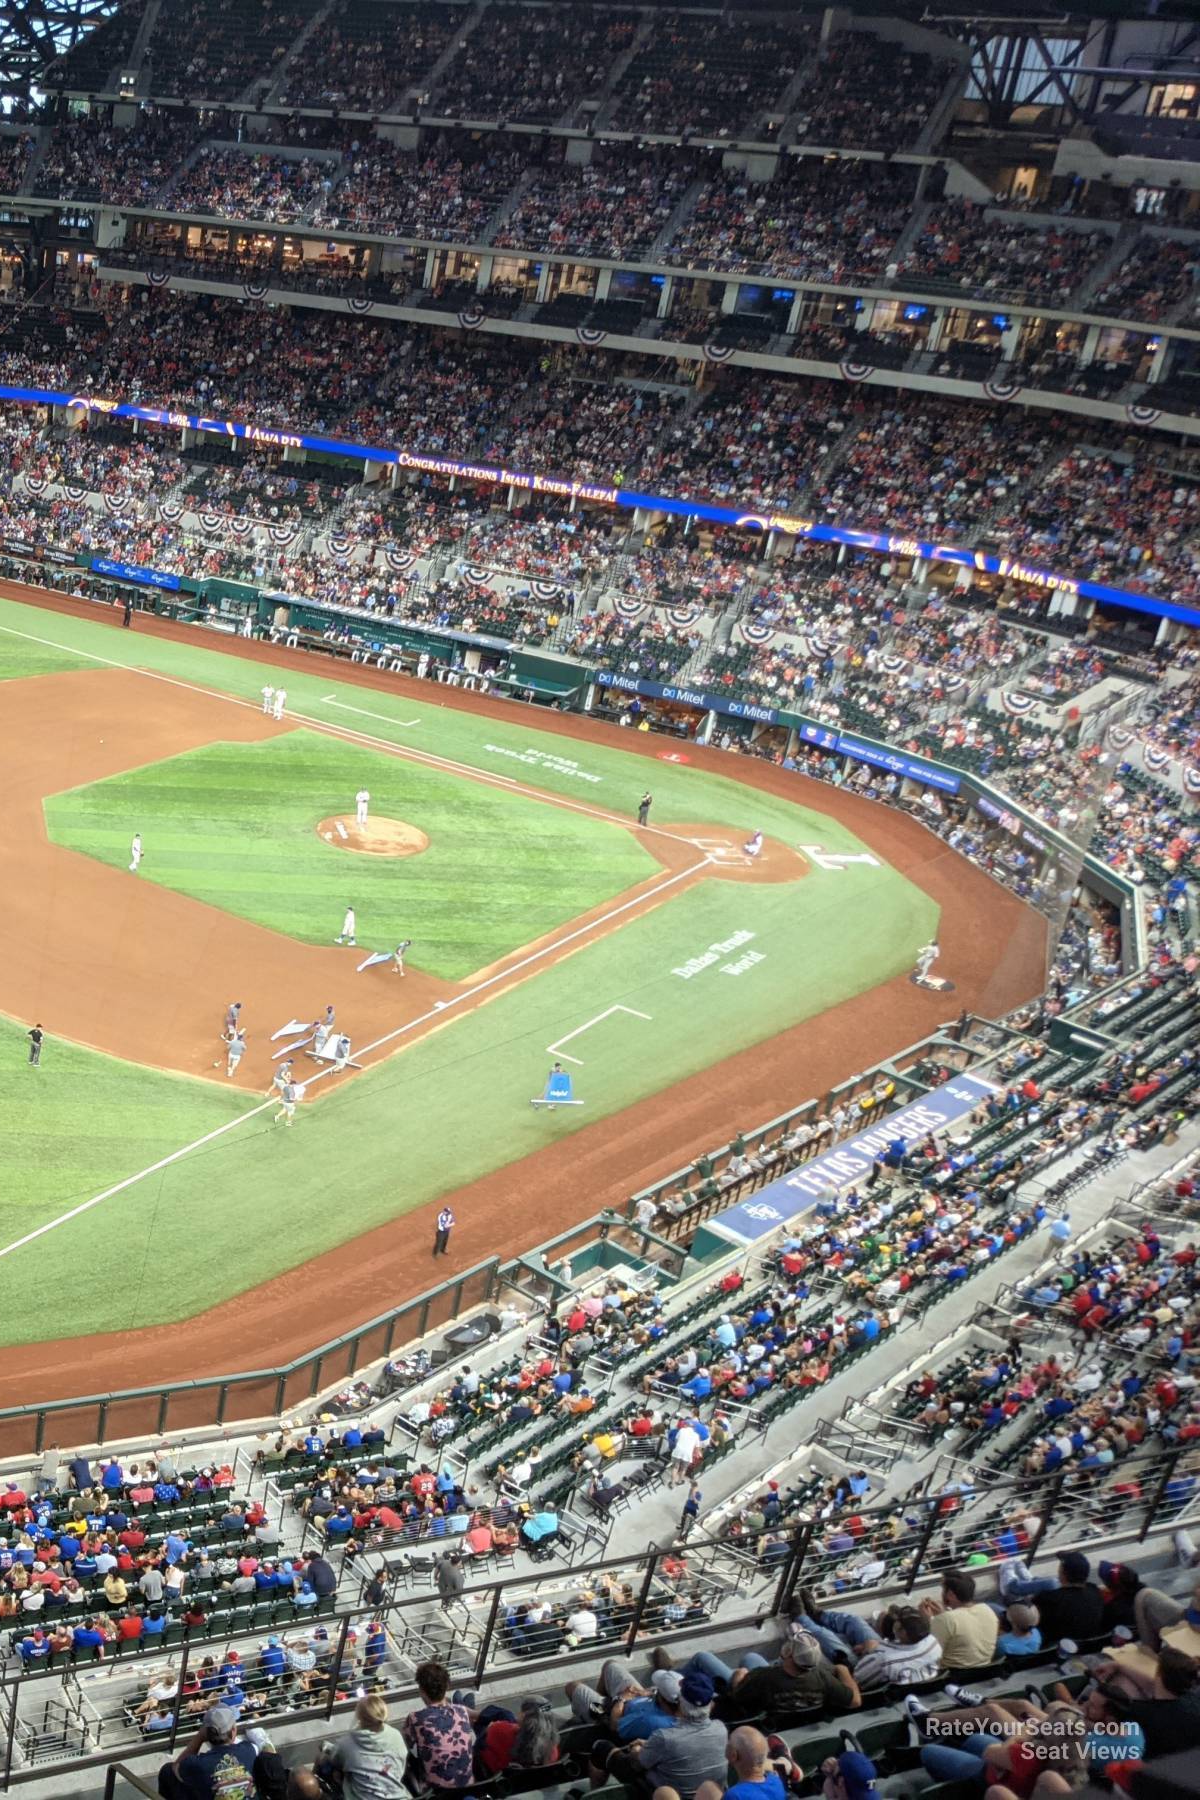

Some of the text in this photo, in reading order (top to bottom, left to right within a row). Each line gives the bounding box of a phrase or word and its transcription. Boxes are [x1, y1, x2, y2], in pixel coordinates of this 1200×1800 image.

[398, 453, 498, 482] CONGRATULATIONS
[611, 674, 639, 691] Mitel
[676, 689, 705, 705] Mitel
[743, 704, 773, 721] Mitel
[671, 929, 756, 979] Dallas Truck
[719, 950, 767, 976] World
[786, 1104, 948, 1196] TEXAS RANGERS
